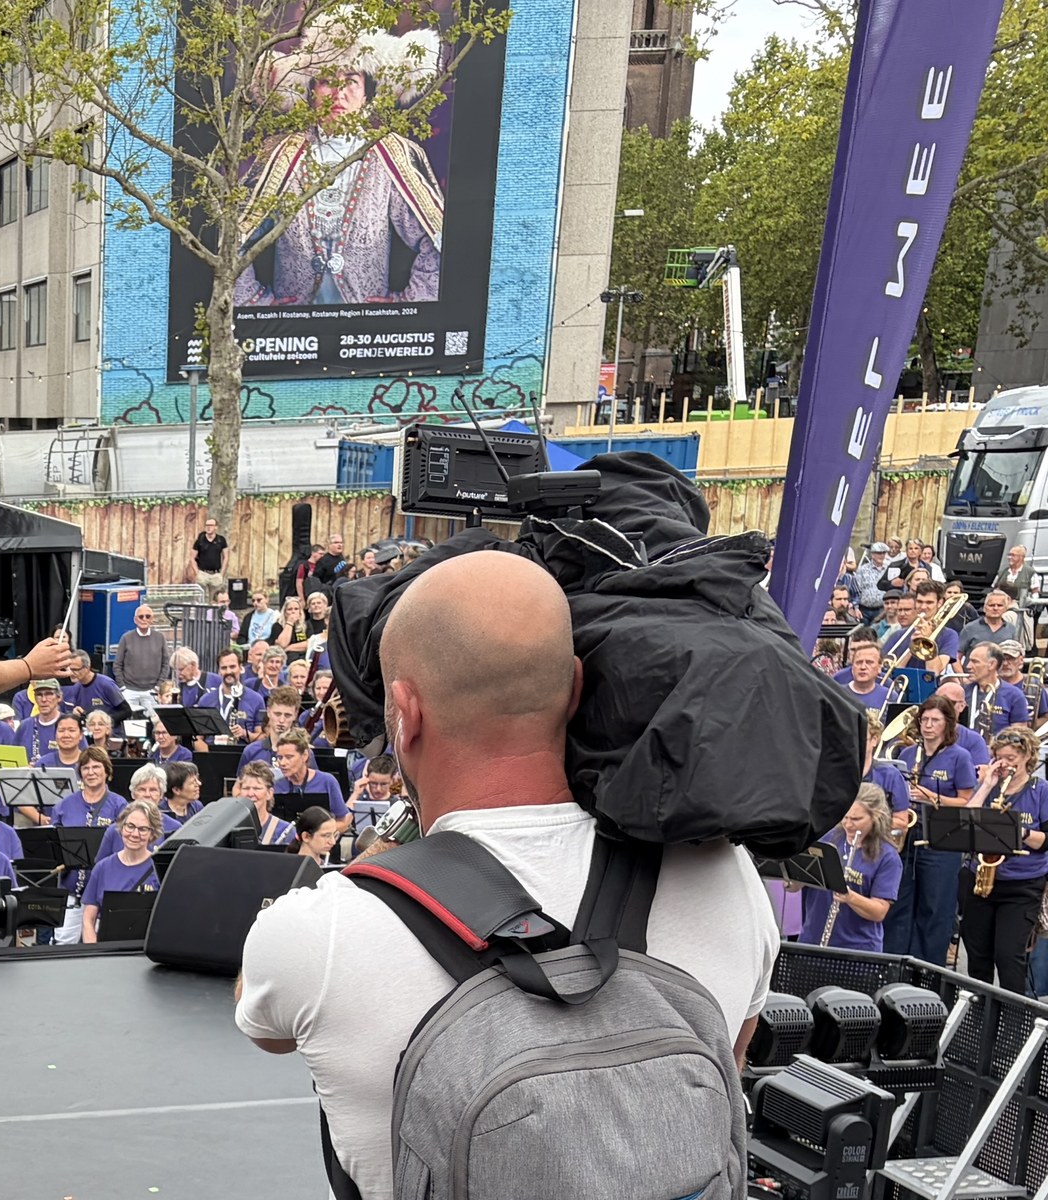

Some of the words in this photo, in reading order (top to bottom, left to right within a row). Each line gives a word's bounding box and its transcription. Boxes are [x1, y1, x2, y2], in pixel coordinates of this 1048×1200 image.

[237, 312, 255, 320] Asem,
[312, 310, 339, 319] Kostanay
[340, 309, 361, 318] Region
[242, 335, 319, 353] OPENING
[340, 334, 371, 345] 28-30
[373, 332, 435, 344] AUGUSTUS
[248, 352, 286, 362] culturele
[287, 352, 318, 361] seizoen
[339, 346, 434, 359] OPENJEWERELD
[959, 552, 983, 563] MAN
[842, 1145, 867, 1156] COLOR
